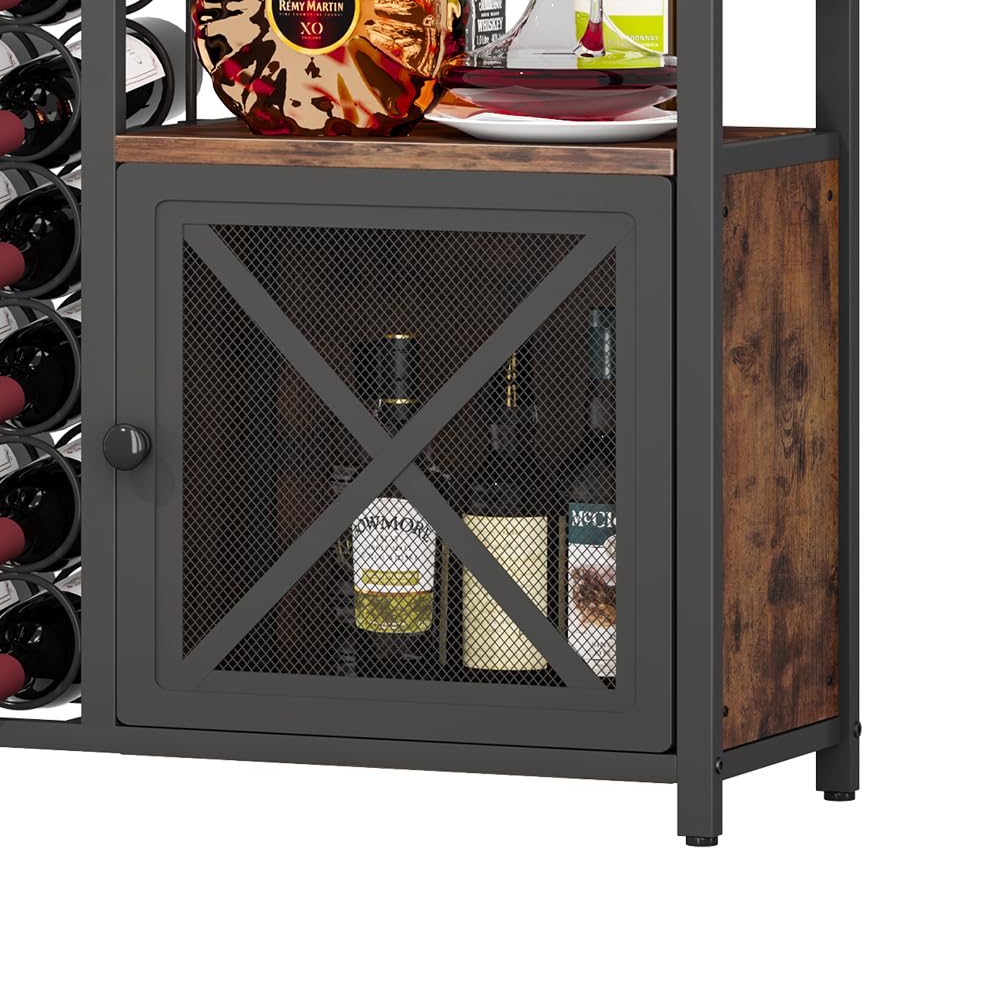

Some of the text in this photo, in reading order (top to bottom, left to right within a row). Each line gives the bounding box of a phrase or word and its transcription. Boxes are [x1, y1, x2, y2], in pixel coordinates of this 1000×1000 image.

[279, 0, 344, 12] RÉMY MARTIN
[300, 21, 324, 35] XO
[477, 17, 504, 33] WHISKEY
